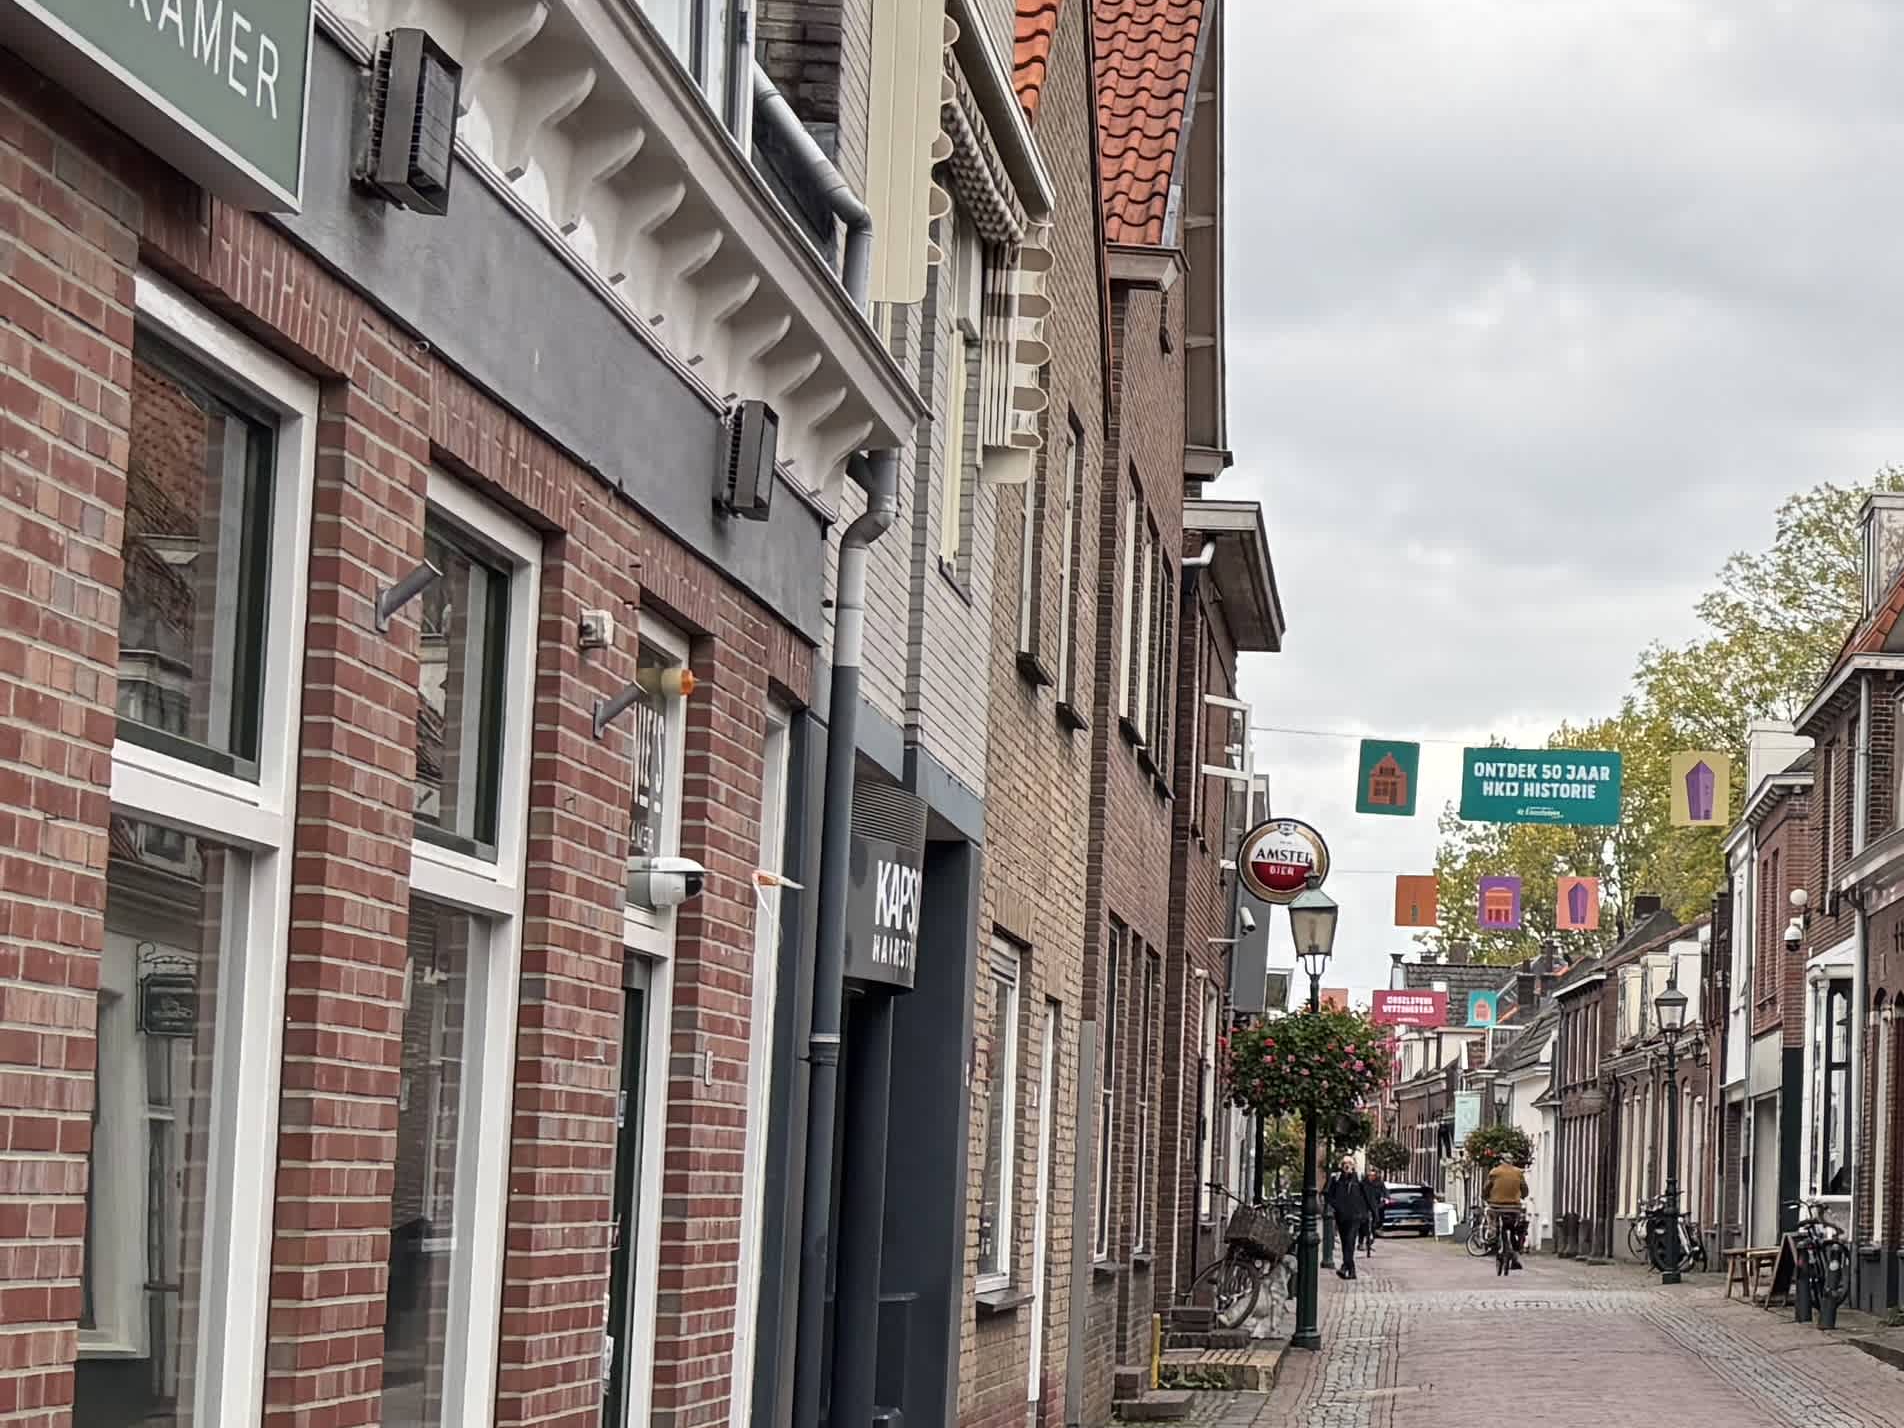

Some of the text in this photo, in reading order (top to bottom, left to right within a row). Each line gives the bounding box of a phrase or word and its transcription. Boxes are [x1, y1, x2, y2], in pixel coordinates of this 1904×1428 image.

[1474, 761, 1611, 781] ONTDEK 50 JAAR
[1523, 783, 1597, 799] HISTORIE
[1255, 847, 1312, 864] AMSTEL
[1269, 865, 1295, 876] BIER
